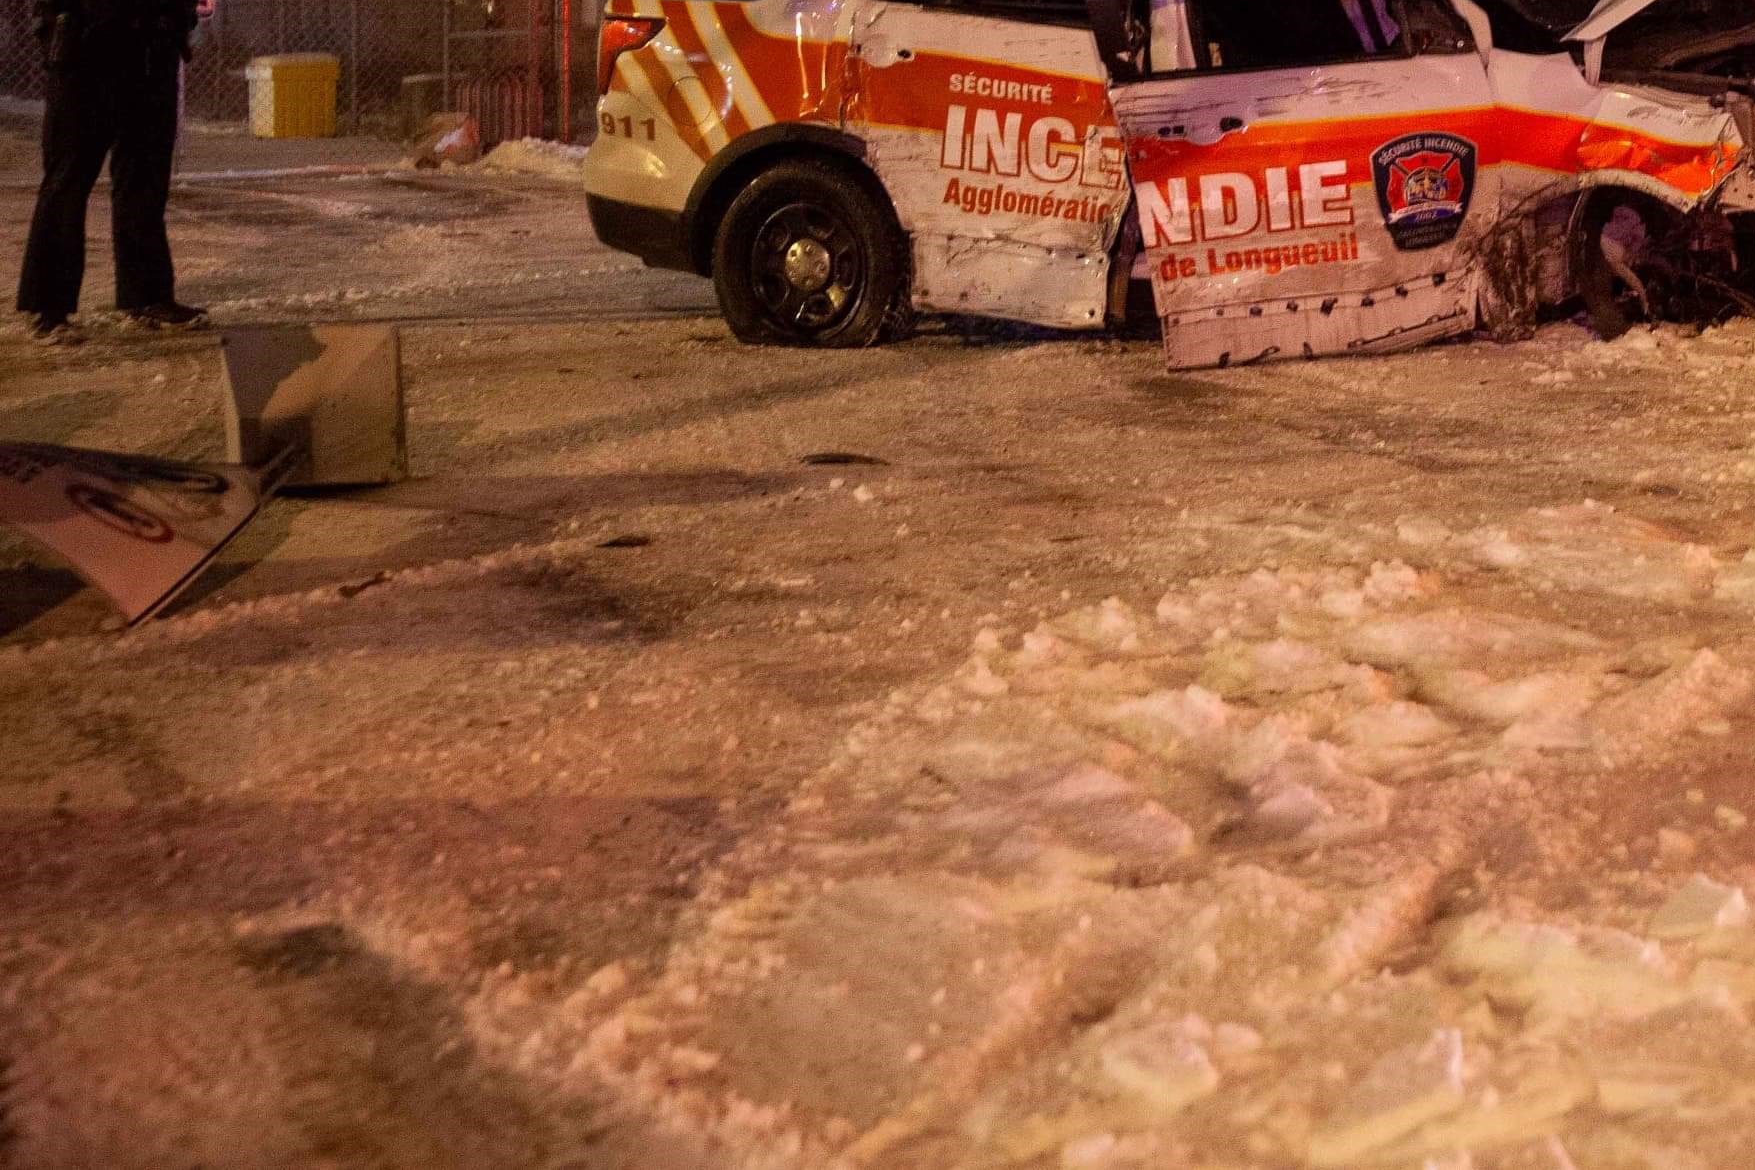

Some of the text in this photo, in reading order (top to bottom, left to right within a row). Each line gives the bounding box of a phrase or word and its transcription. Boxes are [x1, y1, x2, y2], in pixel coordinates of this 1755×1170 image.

[949, 71, 1053, 105] SÉCURITÉ
[601, 112, 656, 142] 911
[1134, 158, 1355, 251] NDIE
[1160, 254, 1197, 281] de
[1207, 232, 1359, 276] Longueuil
